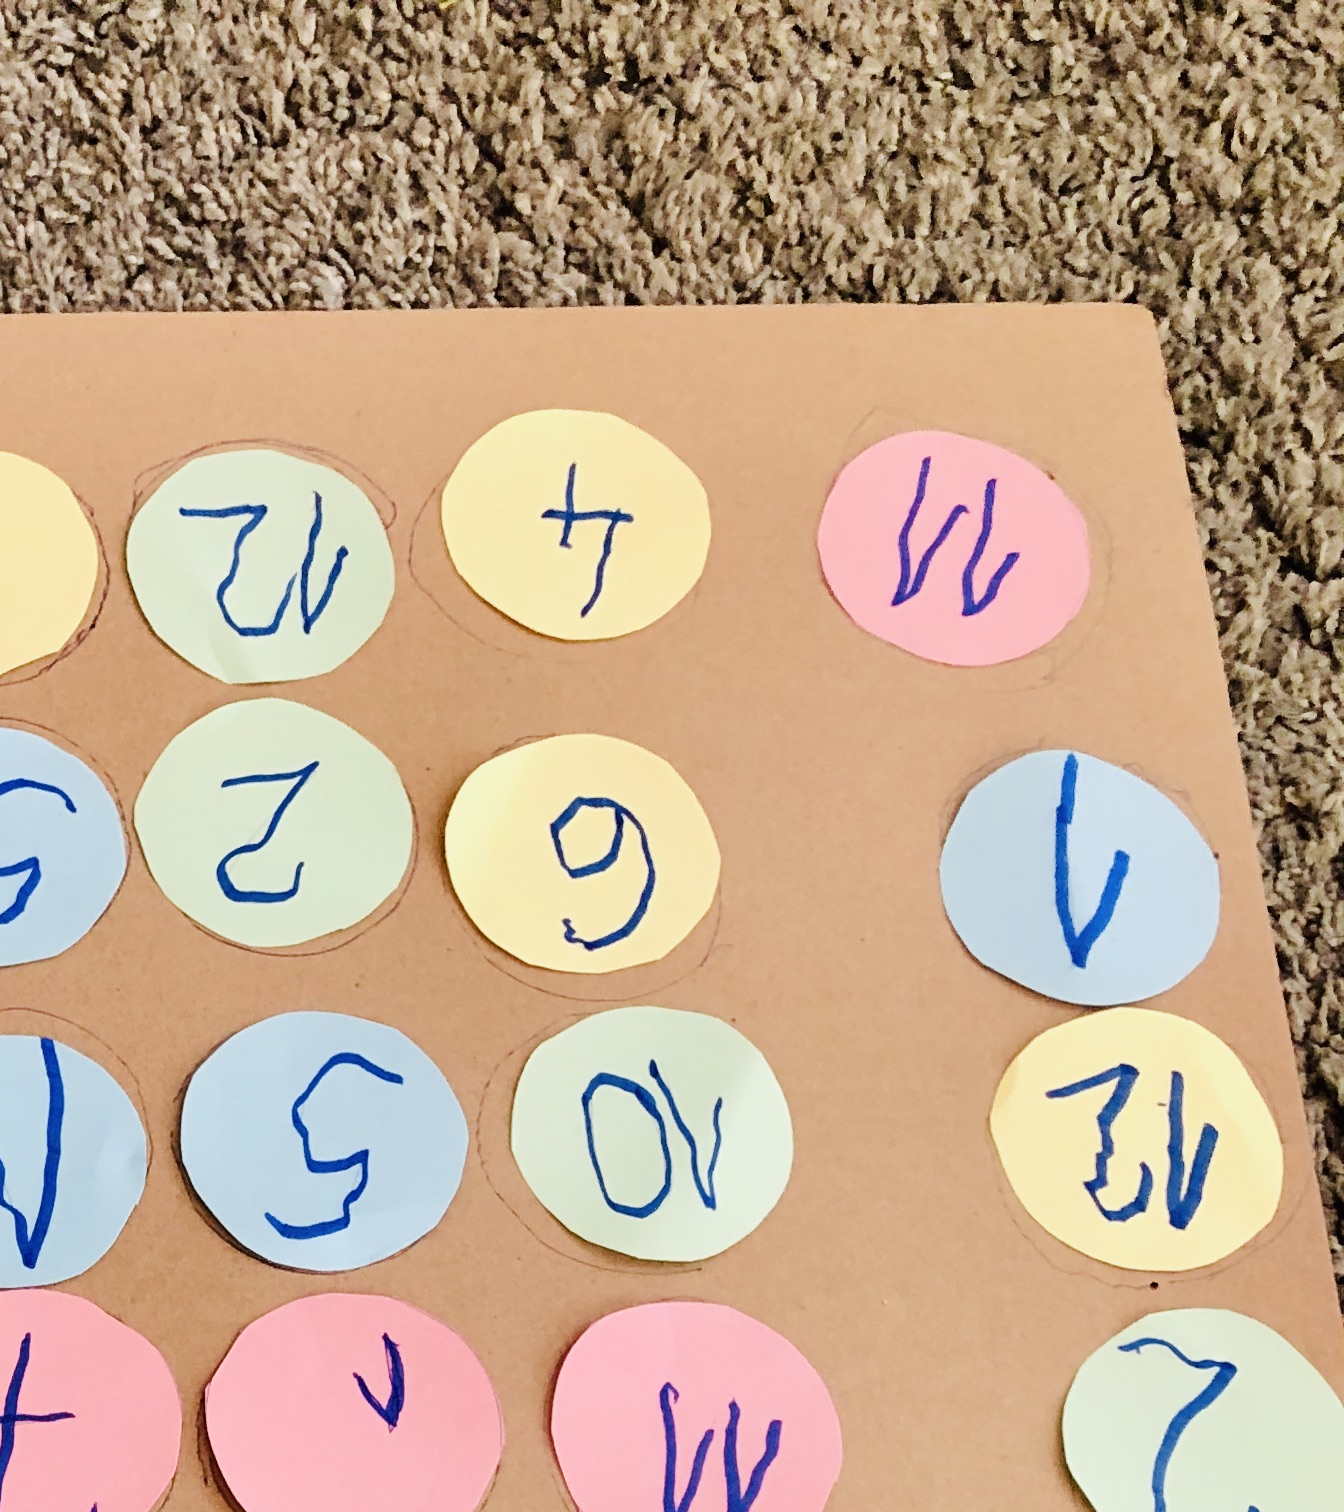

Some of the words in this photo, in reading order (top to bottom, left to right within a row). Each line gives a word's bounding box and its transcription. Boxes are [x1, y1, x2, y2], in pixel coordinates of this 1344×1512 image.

[178, 491, 350, 638] 12
[543, 464, 632, 616] 4
[217, 760, 319, 904] 2
[551, 797, 655, 950] 6
[1054, 754, 1131, 969] 1
[264, 1052, 405, 1240] 5
[581, 1060, 723, 1219] 10
[1047, 1064, 1218, 1229] 12
